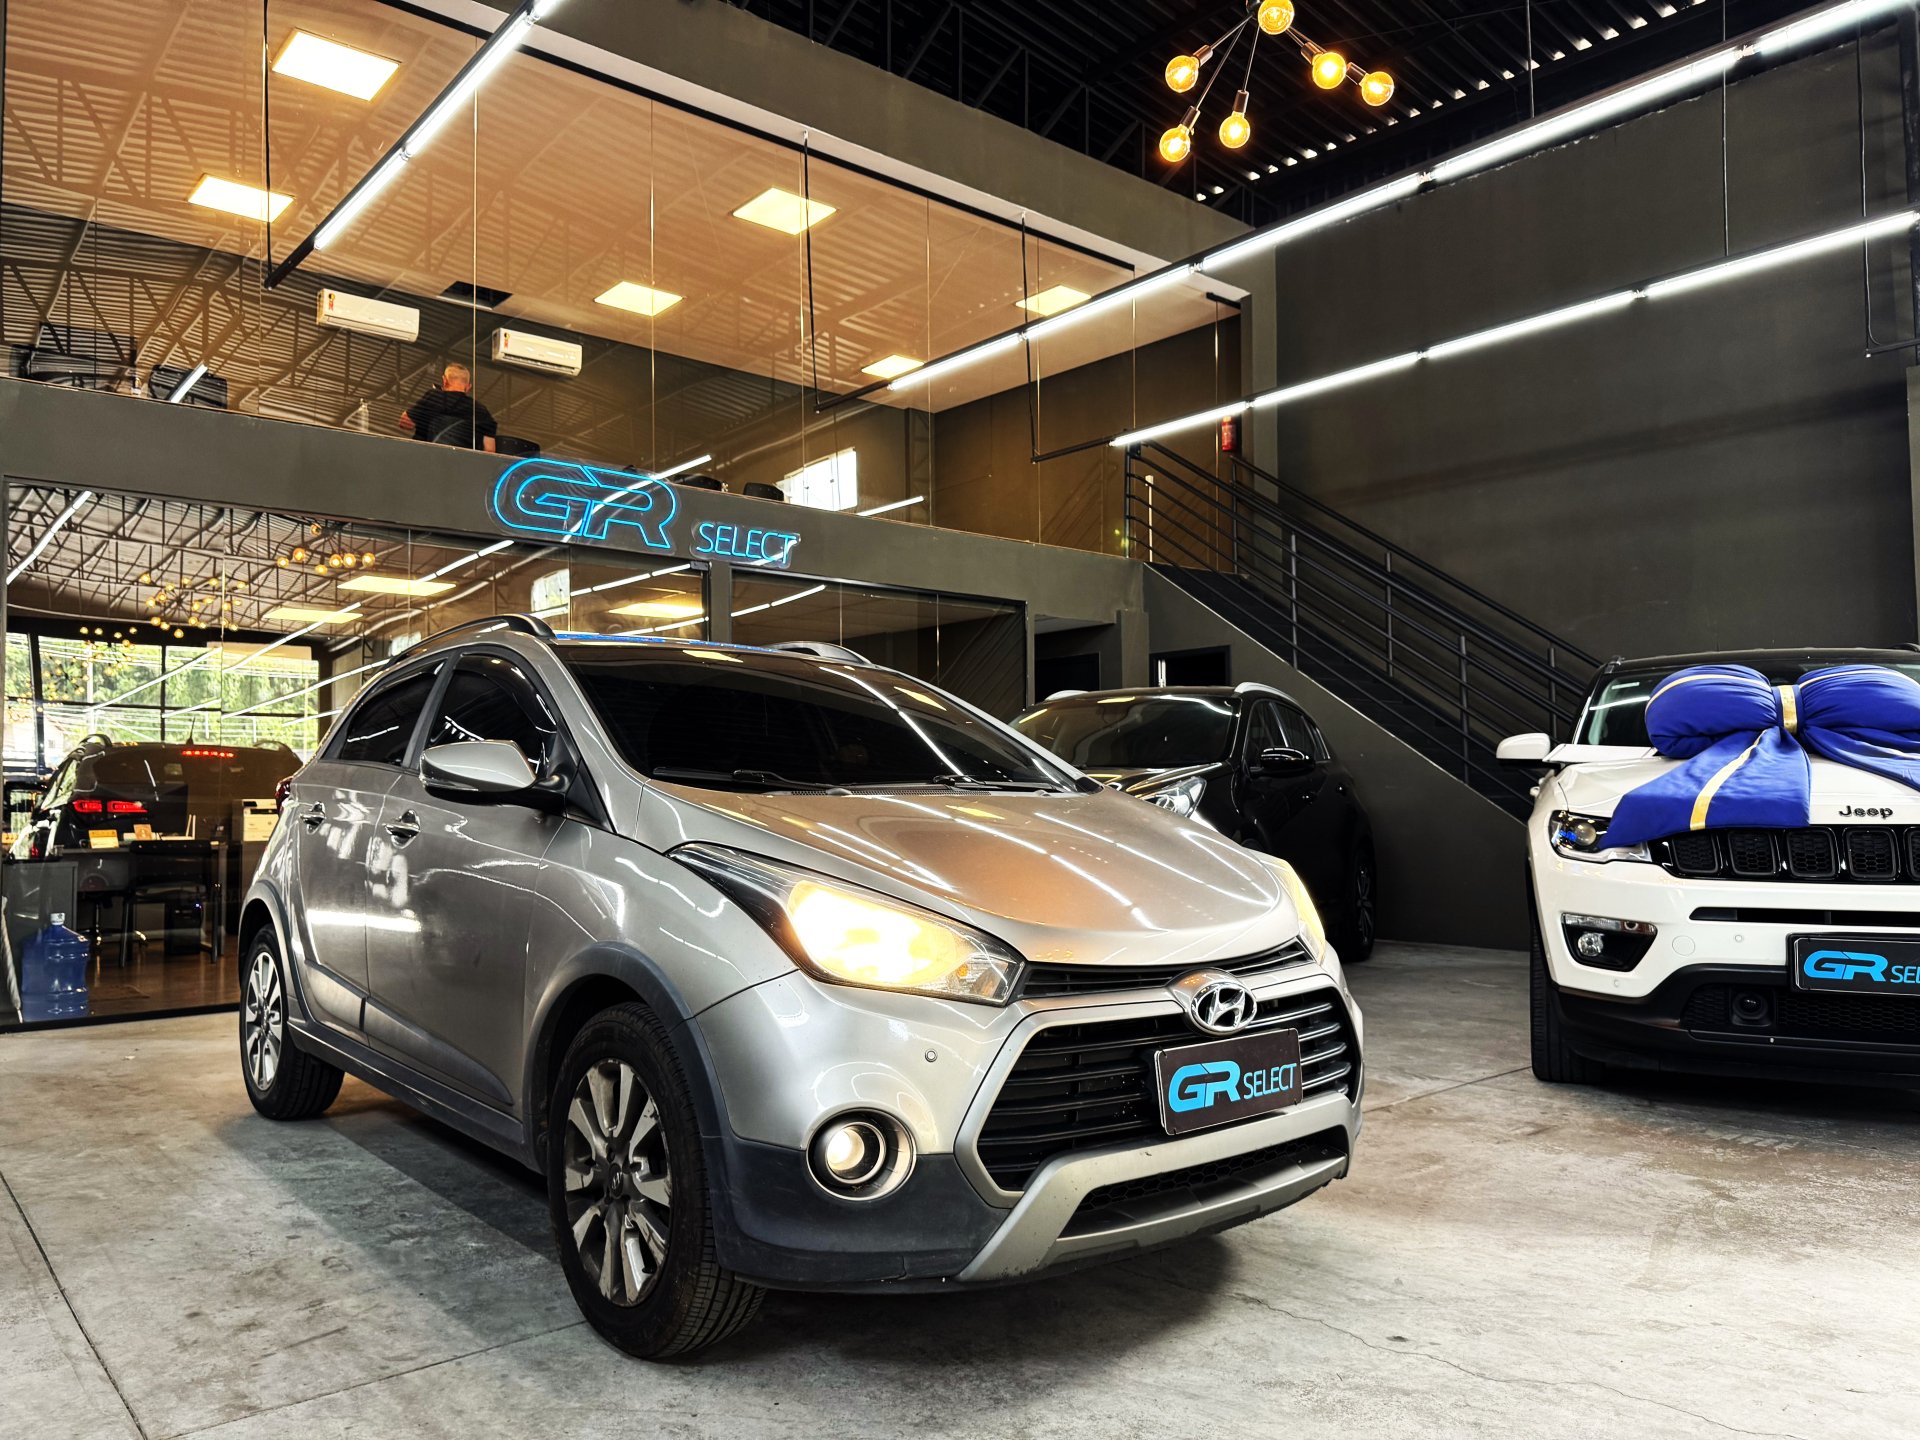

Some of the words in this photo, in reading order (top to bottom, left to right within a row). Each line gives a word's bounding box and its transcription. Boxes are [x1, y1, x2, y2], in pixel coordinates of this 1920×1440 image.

[493, 457, 677, 549] GR
[695, 522, 798, 565] SELECT
[1838, 805, 1893, 820] Jeep
[1803, 950, 1889, 982] GR
[1168, 1060, 1242, 1113] GR
[1243, 1063, 1297, 1100] SELECT
